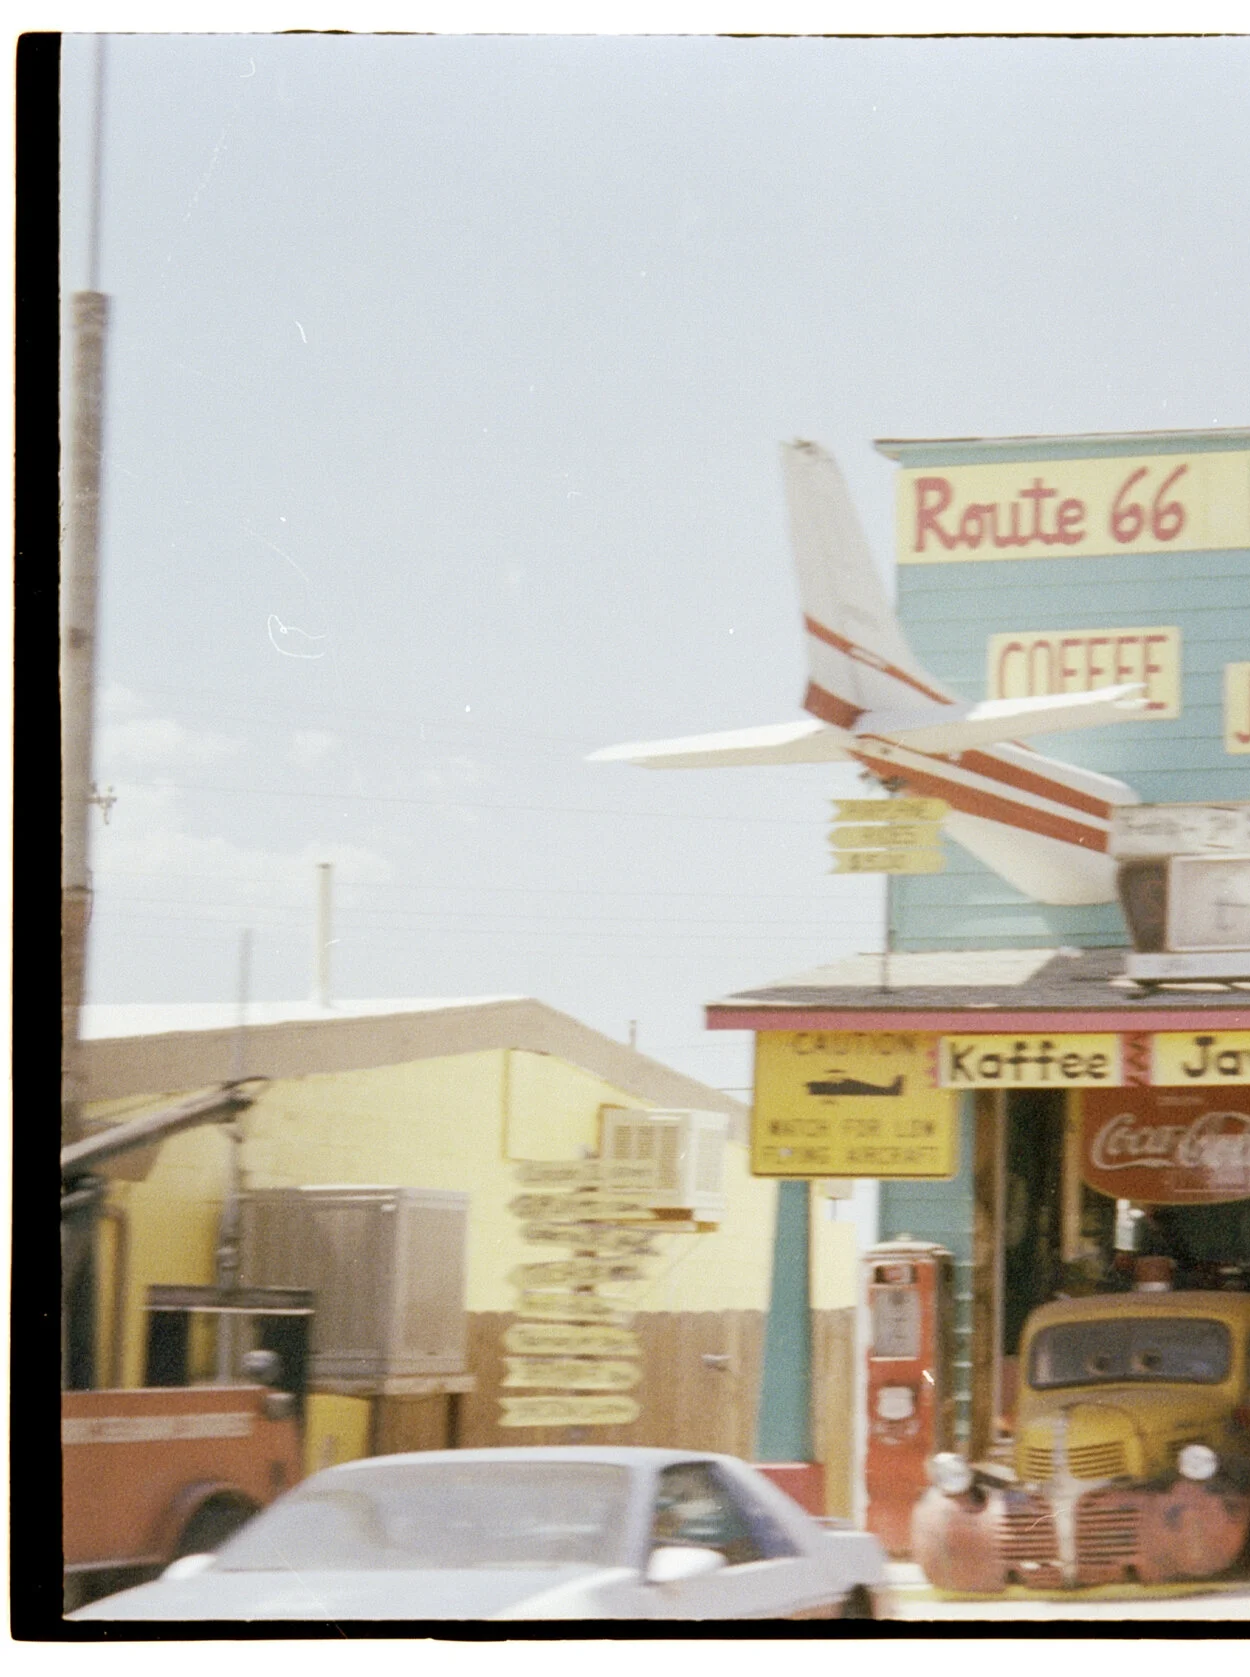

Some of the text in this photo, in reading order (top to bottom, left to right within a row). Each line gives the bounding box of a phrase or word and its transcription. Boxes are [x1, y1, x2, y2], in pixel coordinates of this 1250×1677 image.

[913, 475, 1088, 553] Route
[1109, 462, 1190, 543] 66
[996, 633, 1168, 711] COFFEE
[950, 1038, 1112, 1082] Kaffee
